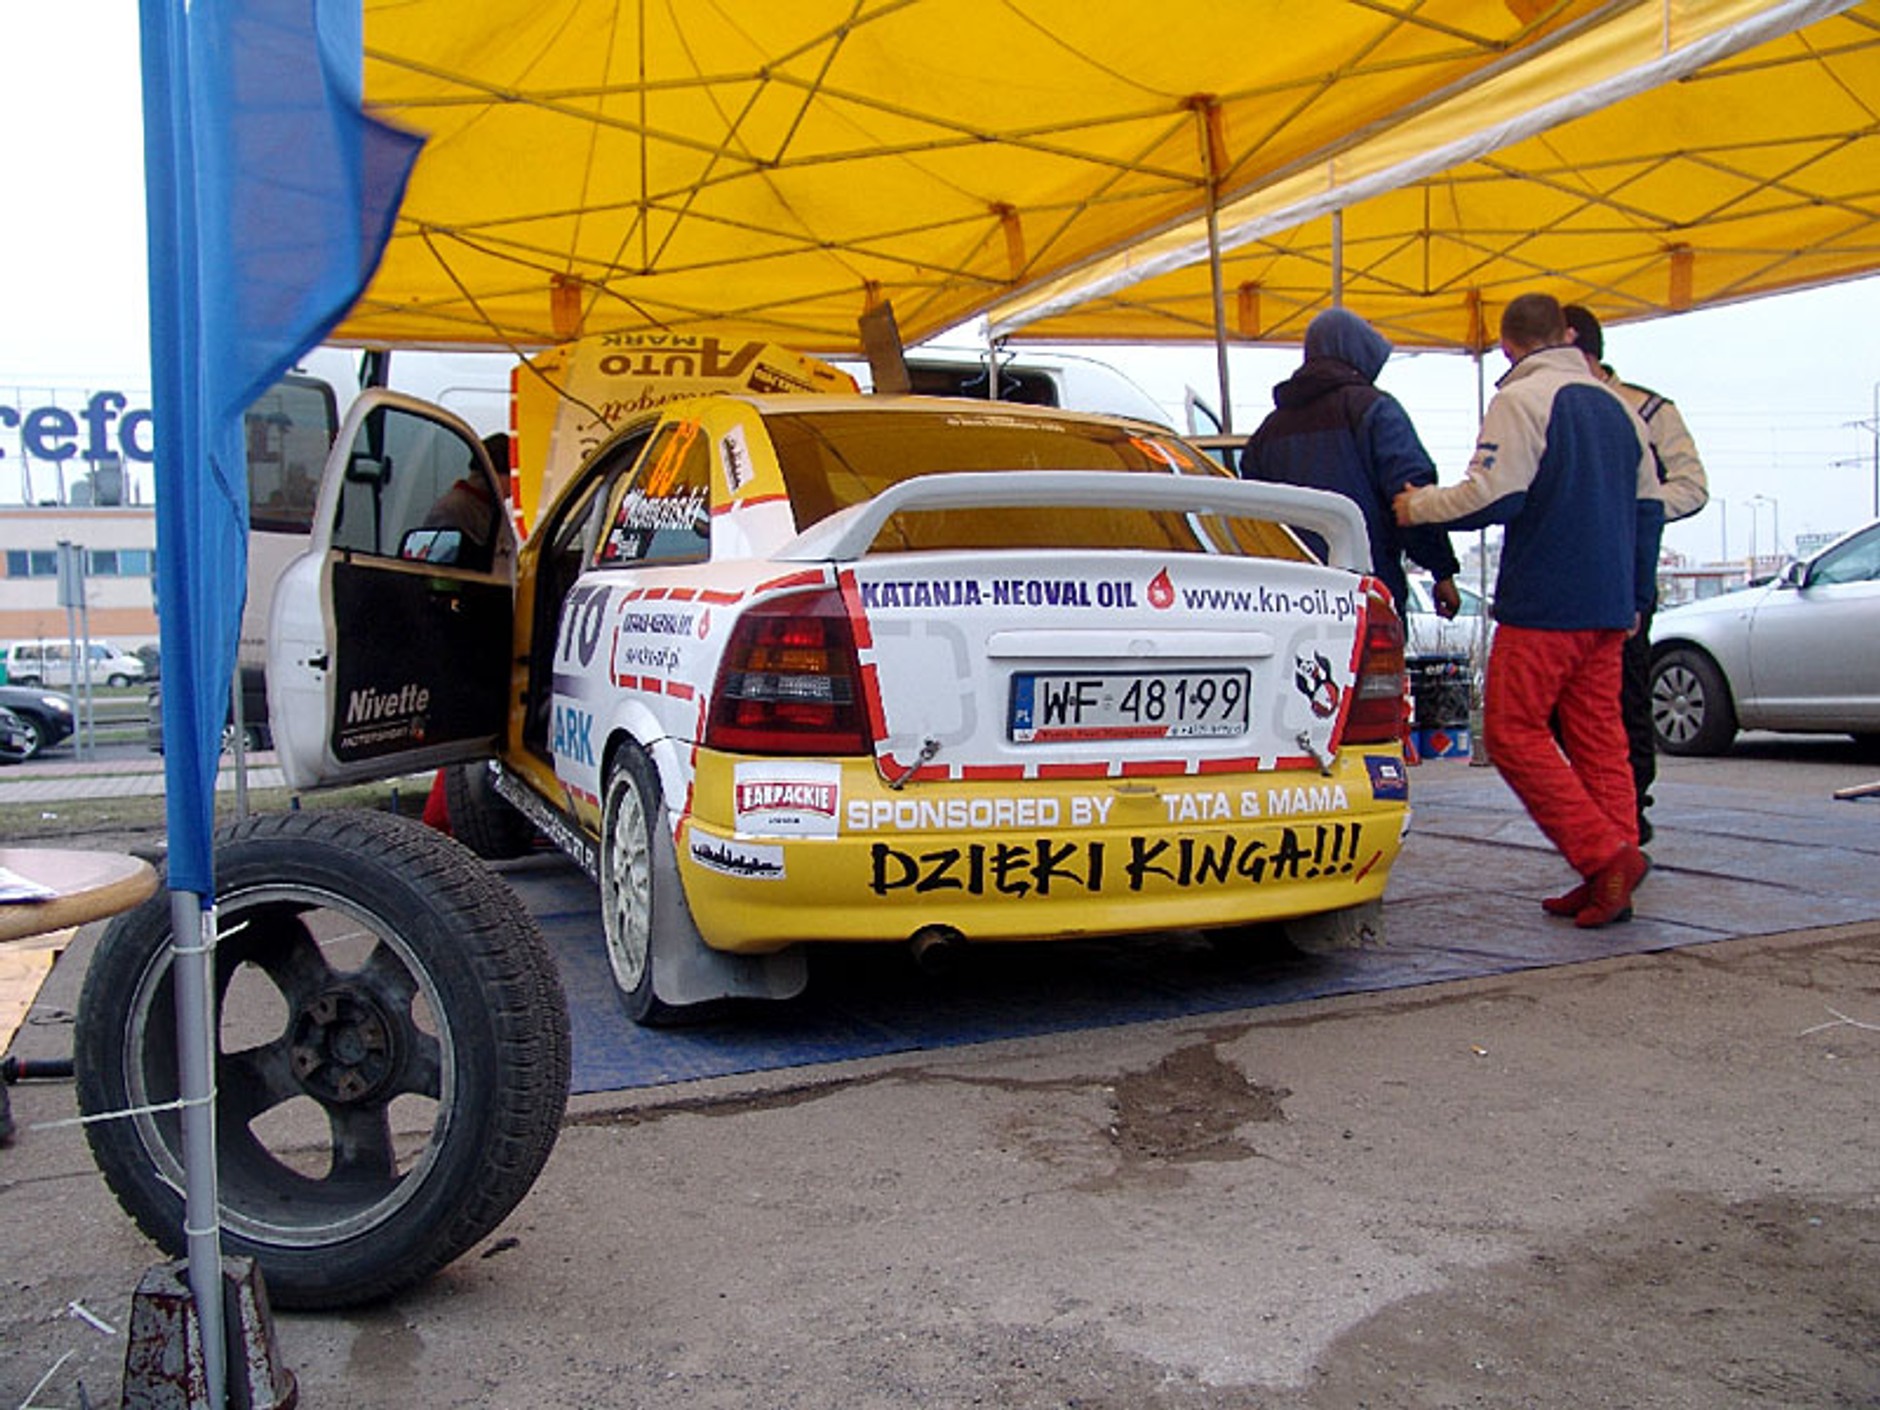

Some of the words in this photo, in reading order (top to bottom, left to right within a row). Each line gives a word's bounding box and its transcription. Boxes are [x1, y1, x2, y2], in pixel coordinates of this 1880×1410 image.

[599, 337, 768, 378] AUTO
[601, 334, 697, 347] MARK
[861, 580, 1092, 608] KATANJA-NEOVAL
[1096, 581, 1138, 609] OIL
[1183, 586, 1355, 621] www.kn-oil.pl
[347, 683, 430, 724] Nivette
[1015, 708, 1031, 723] PL
[1043, 680, 1103, 725] WF
[1119, 677, 1242, 723] 48199
[554, 705, 596, 768] ARK
[847, 797, 1060, 829] SPONSORED
[1071, 795, 1115, 826] BY
[1161, 789, 1233, 823] TATA
[1240, 789, 1261, 818] &
[1267, 783, 1350, 816] MAMA
[868, 838, 1105, 898] DZIĘKI
[1125, 822, 1362, 891] KINGA!!!
